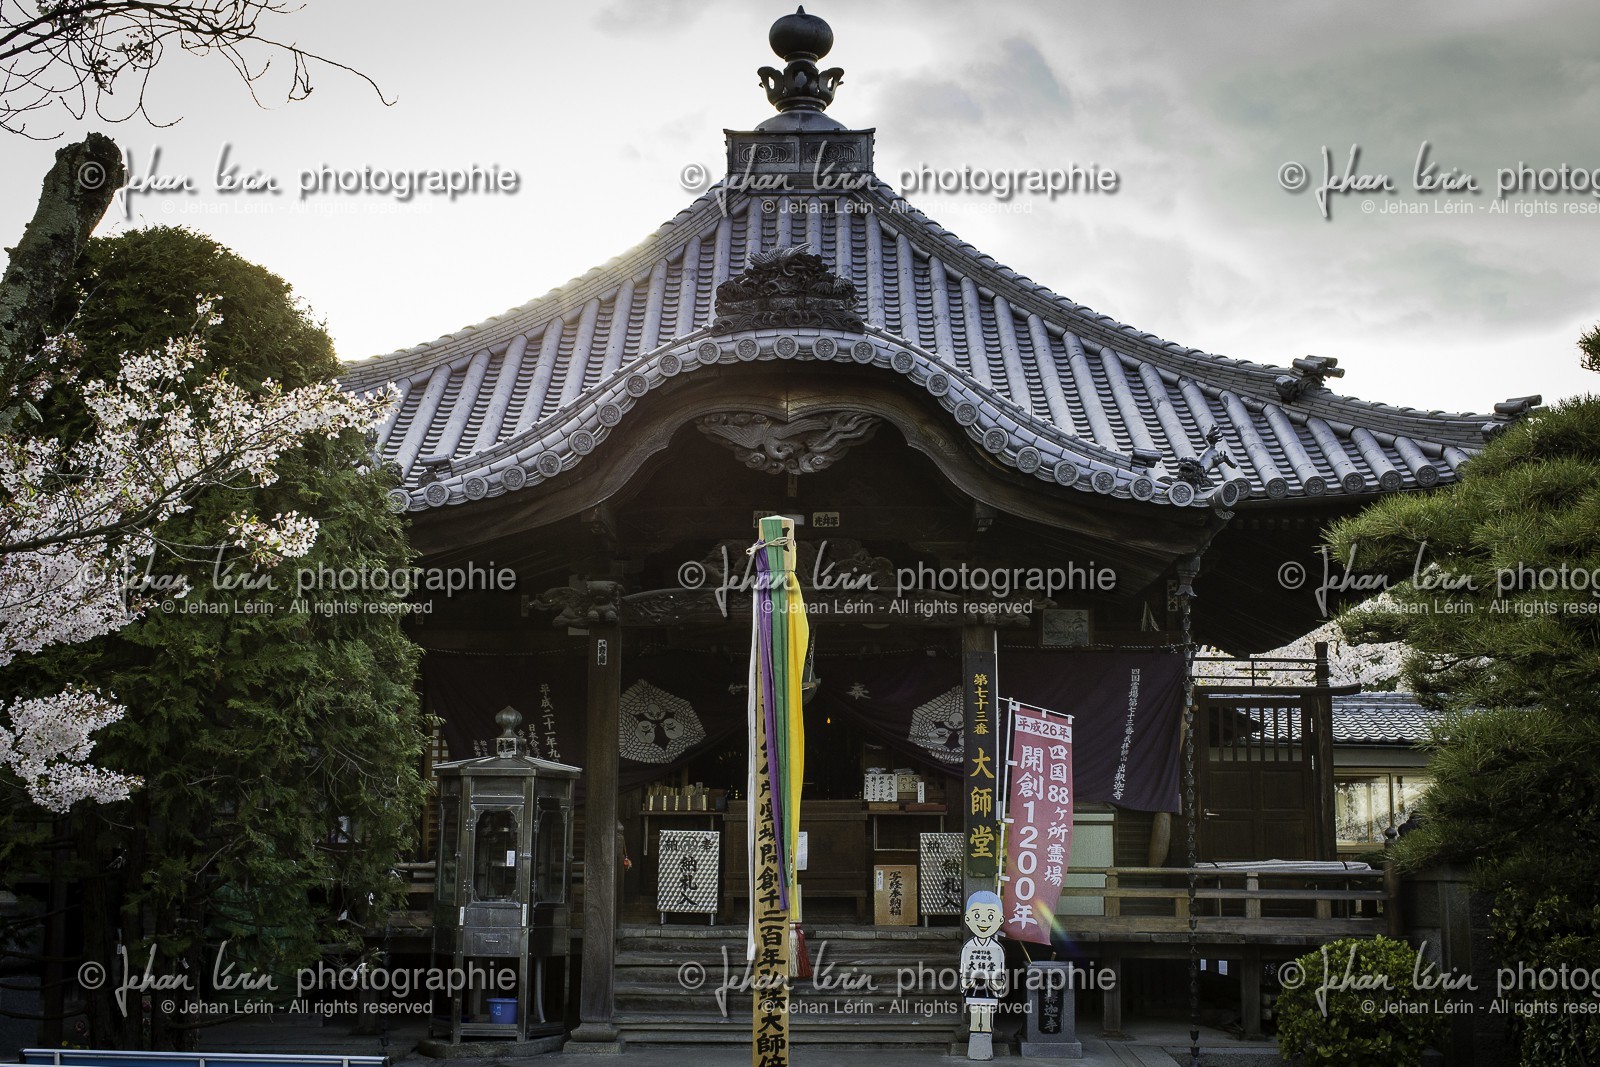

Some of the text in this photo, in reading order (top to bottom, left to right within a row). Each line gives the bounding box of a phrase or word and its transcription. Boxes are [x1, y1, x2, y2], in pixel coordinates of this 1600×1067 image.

[970, 673, 995, 858] 第七十三番 大師堂
[1018, 717, 1070, 740] 平成26年
[1008, 744, 1045, 930] 開創1200年
